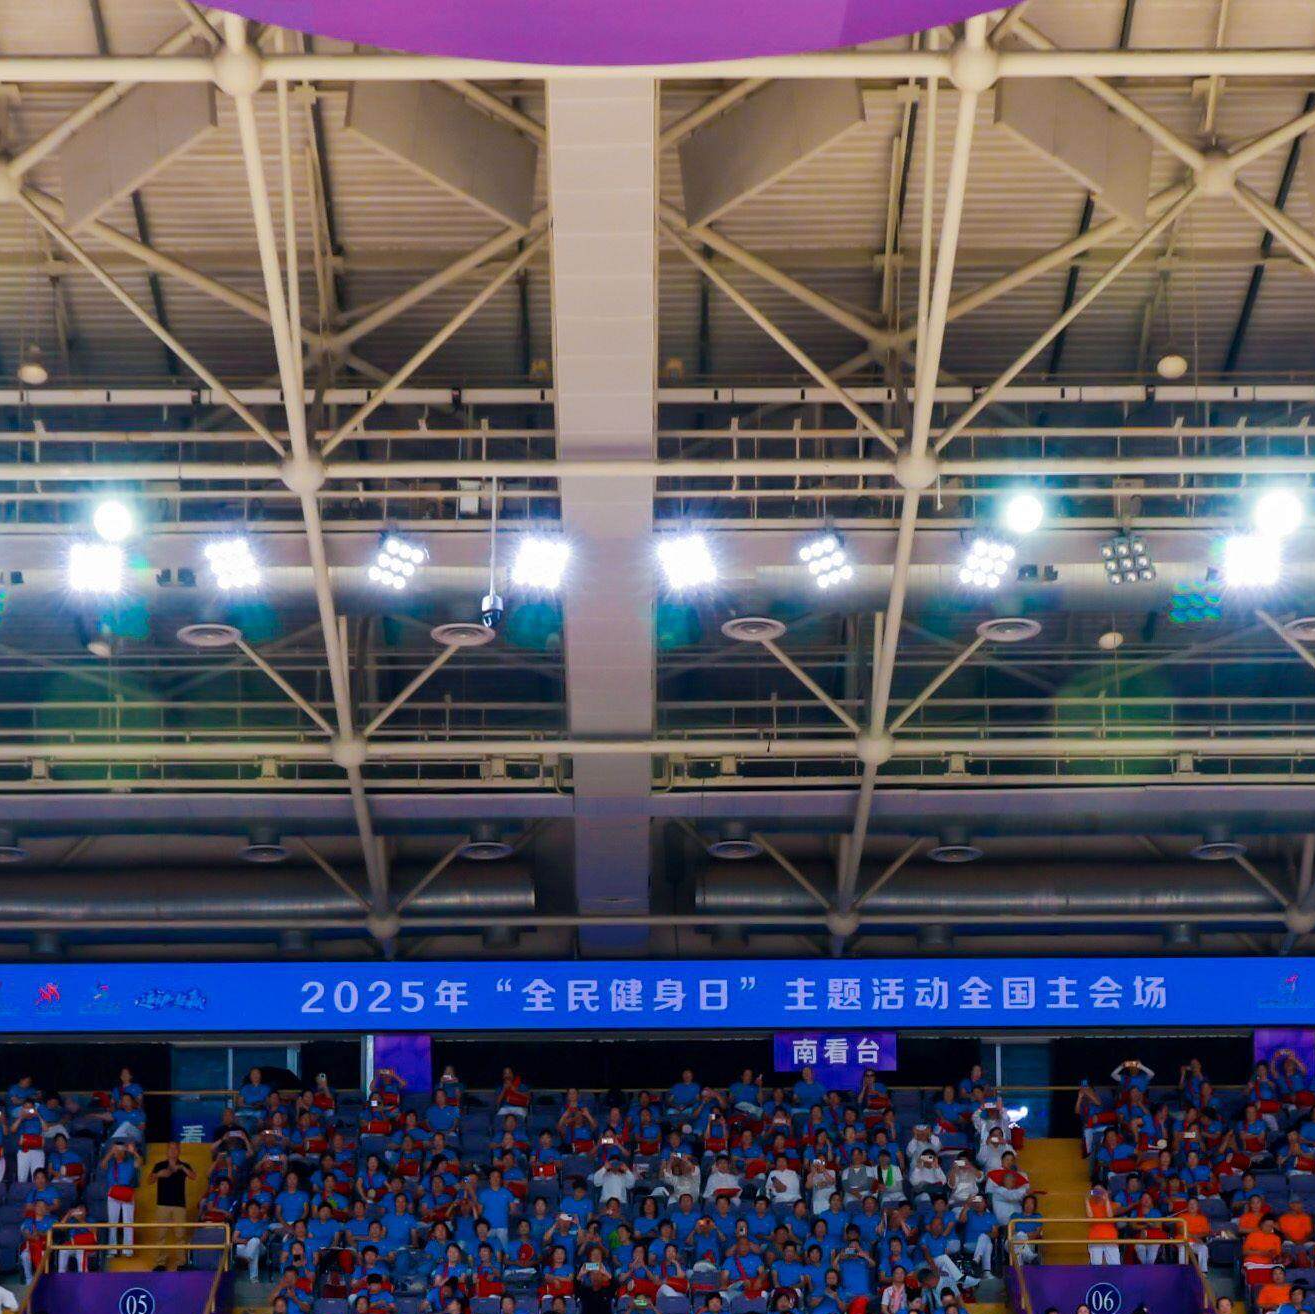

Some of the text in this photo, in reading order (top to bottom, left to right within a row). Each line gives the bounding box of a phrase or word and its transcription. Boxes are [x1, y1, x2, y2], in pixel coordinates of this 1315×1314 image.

[792, 1037, 880, 1064] 南看台
[1091, 1290, 1113, 1312] 06
